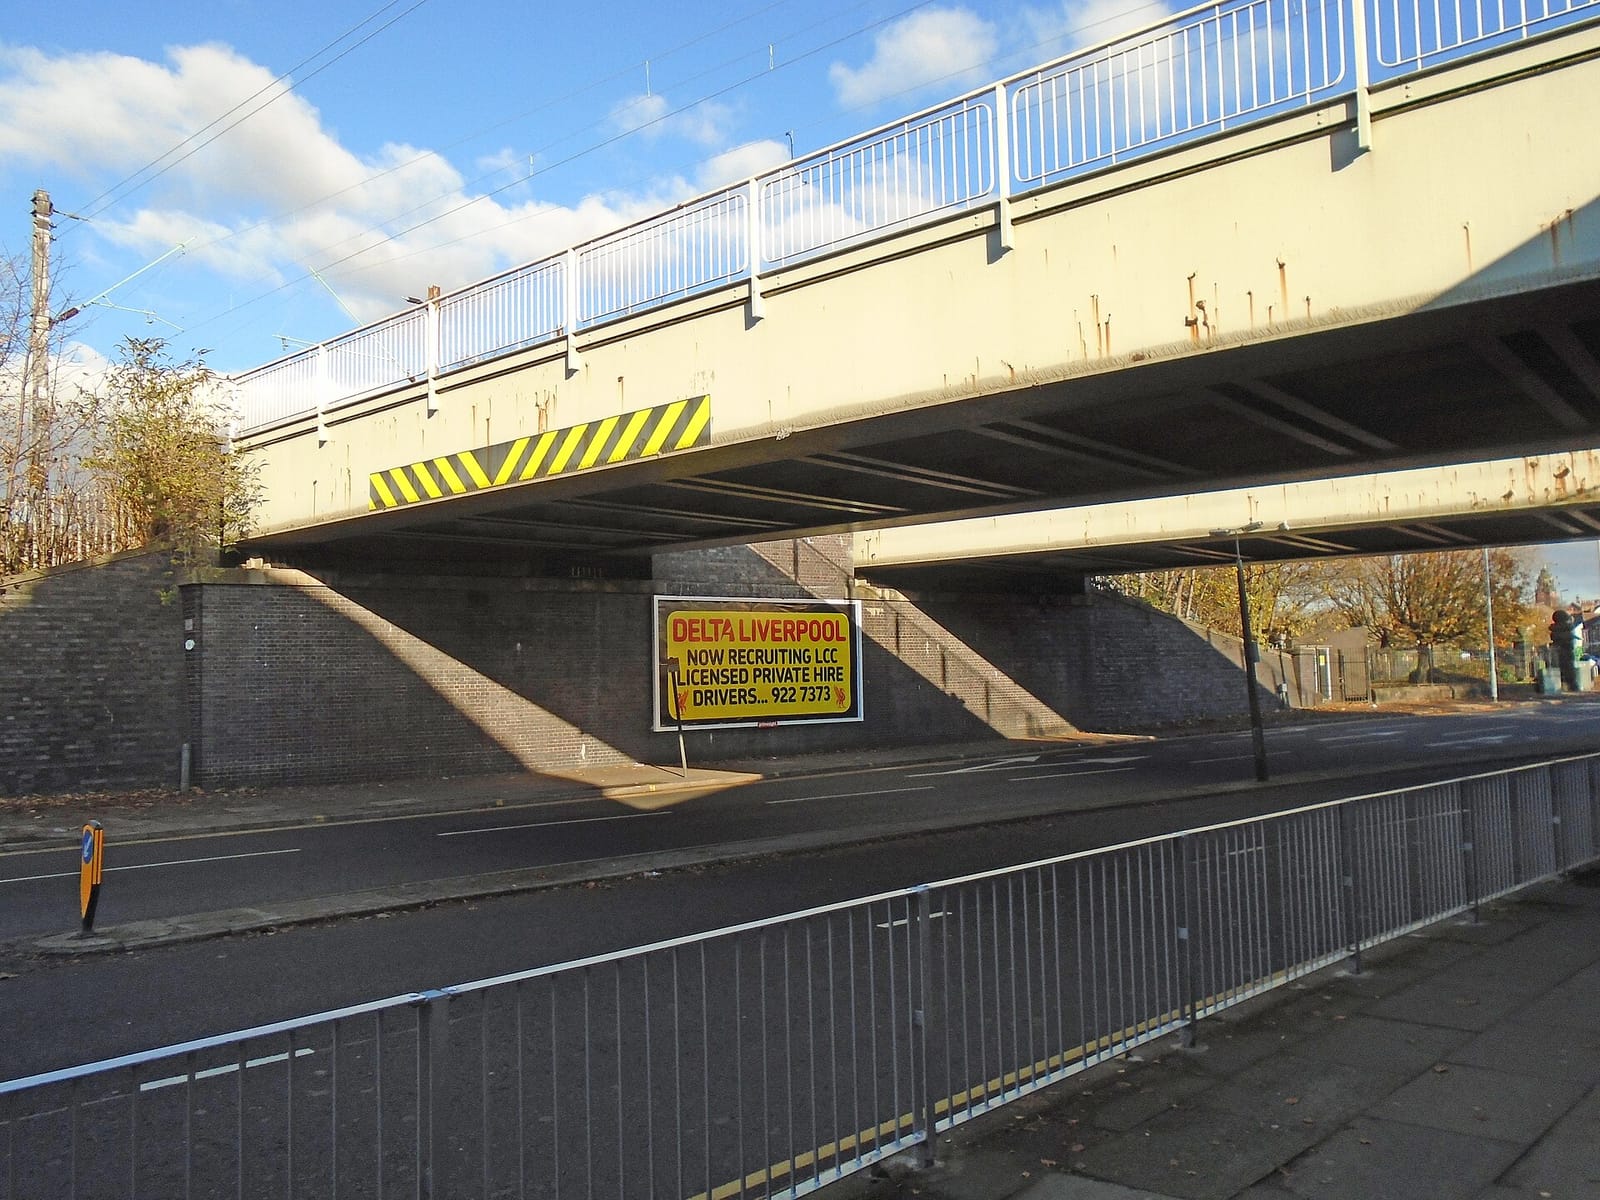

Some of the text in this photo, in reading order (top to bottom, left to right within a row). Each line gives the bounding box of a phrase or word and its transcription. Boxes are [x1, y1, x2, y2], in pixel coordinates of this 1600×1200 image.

[673, 618, 846, 642] DELTA LIVERPOOL
[687, 648, 838, 666] NOW RECRUITING LCC
[677, 666, 844, 686] LICENSED PRIVATE HIRE
[693, 686, 831, 706] DRIVERS... 922 7373
